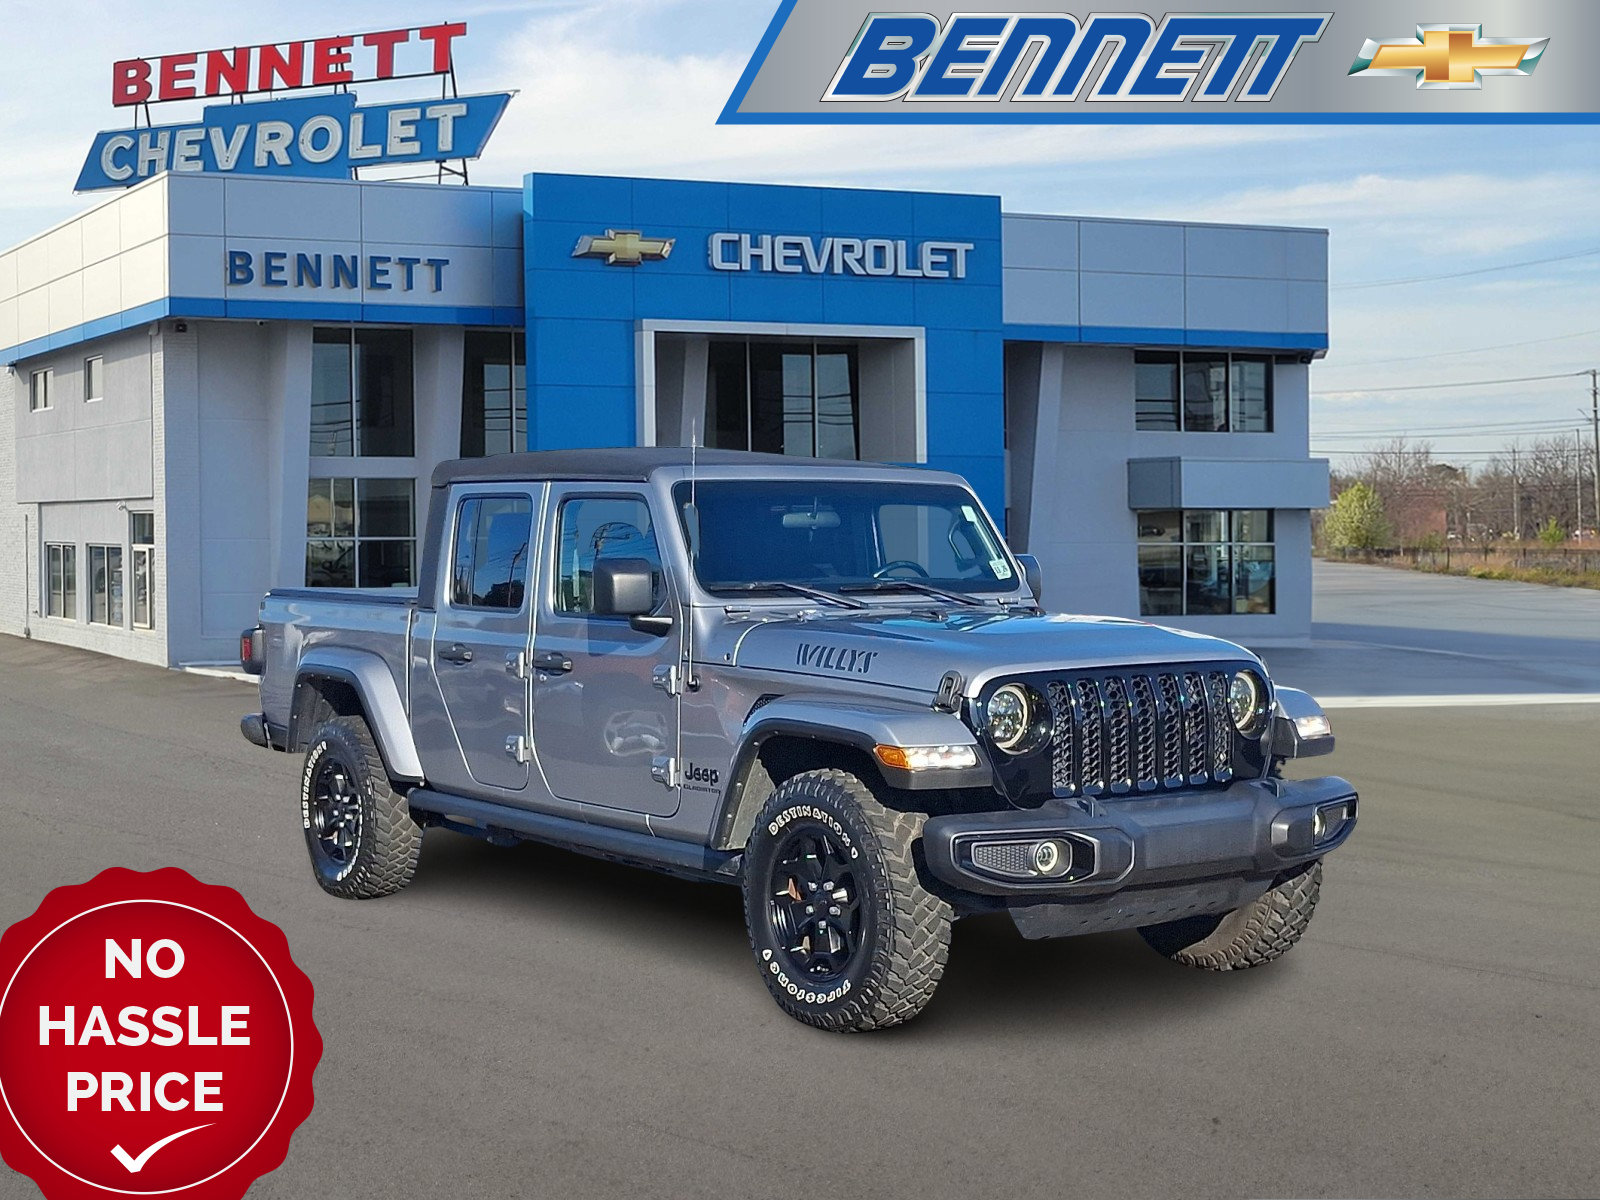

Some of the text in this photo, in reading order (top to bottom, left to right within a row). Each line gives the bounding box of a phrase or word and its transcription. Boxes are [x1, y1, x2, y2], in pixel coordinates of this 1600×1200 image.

[113, 22, 467, 106] BENNETT
[100, 103, 468, 181] CHEVROLET
[226, 250, 450, 292] BENNETT
[708, 232, 974, 279] CHEVROLET
[796, 643, 878, 673] WILLYS
[684, 762, 719, 786] Jeep
